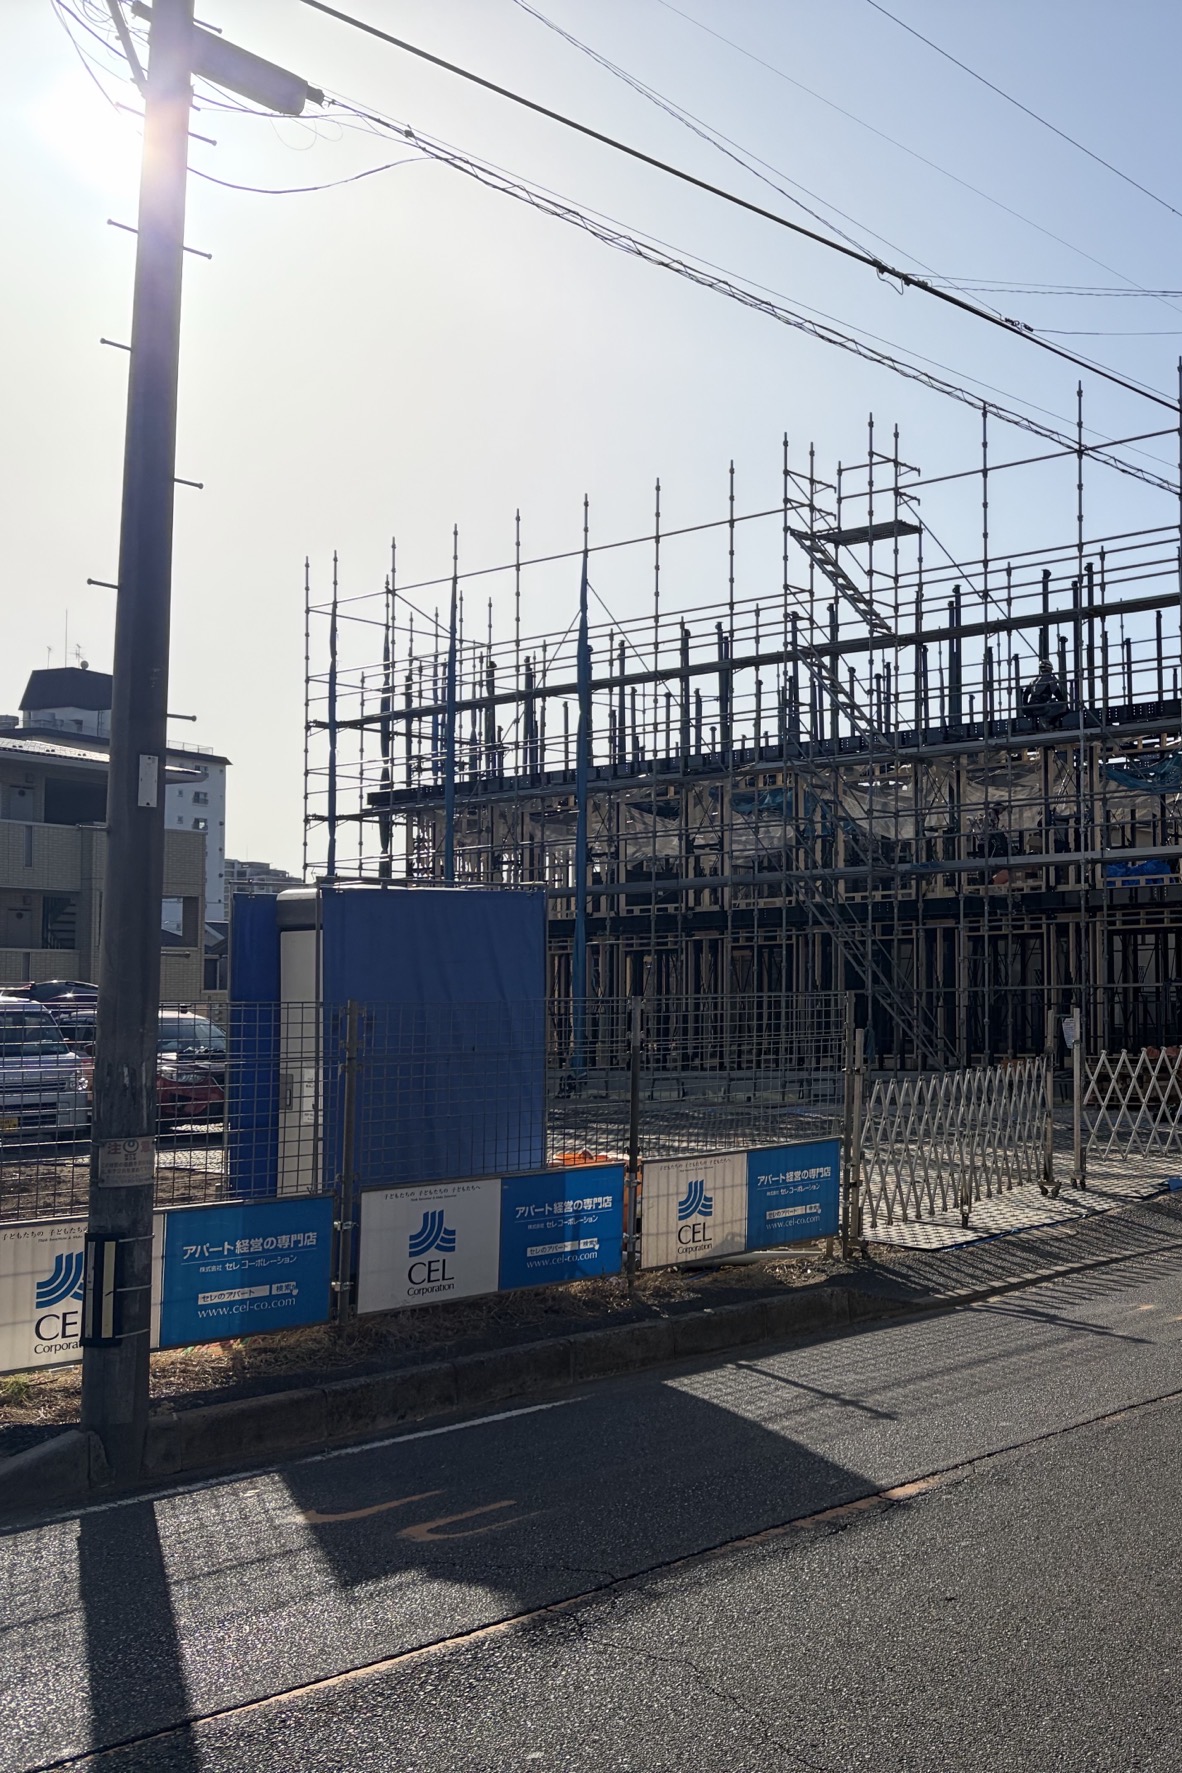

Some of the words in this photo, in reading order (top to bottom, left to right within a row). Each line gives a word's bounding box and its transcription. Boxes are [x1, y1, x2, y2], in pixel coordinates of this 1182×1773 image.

[757, 1167, 831, 1186] アパート経営の専門店
[515, 1196, 613, 1219] アパート経営の専門店
[766, 1215, 820, 1229] www.cel-co.com
[677, 1222, 712, 1245] CEL
[182, 1232, 317, 1259] アパート経営の専門店
[529, 1244, 568, 1255] セレのアパート
[677, 1243, 712, 1254] Corporation
[526, 1251, 598, 1269] www.cel-co.com
[407, 1259, 455, 1285] CEL
[202, 1289, 255, 1303] セレのアパート
[407, 1282, 455, 1297] Corporation
[197, 1297, 296, 1318] www.cel-co.com
[34, 1311, 79, 1341] CE
[34, 1341, 82, 1354] Corpora
